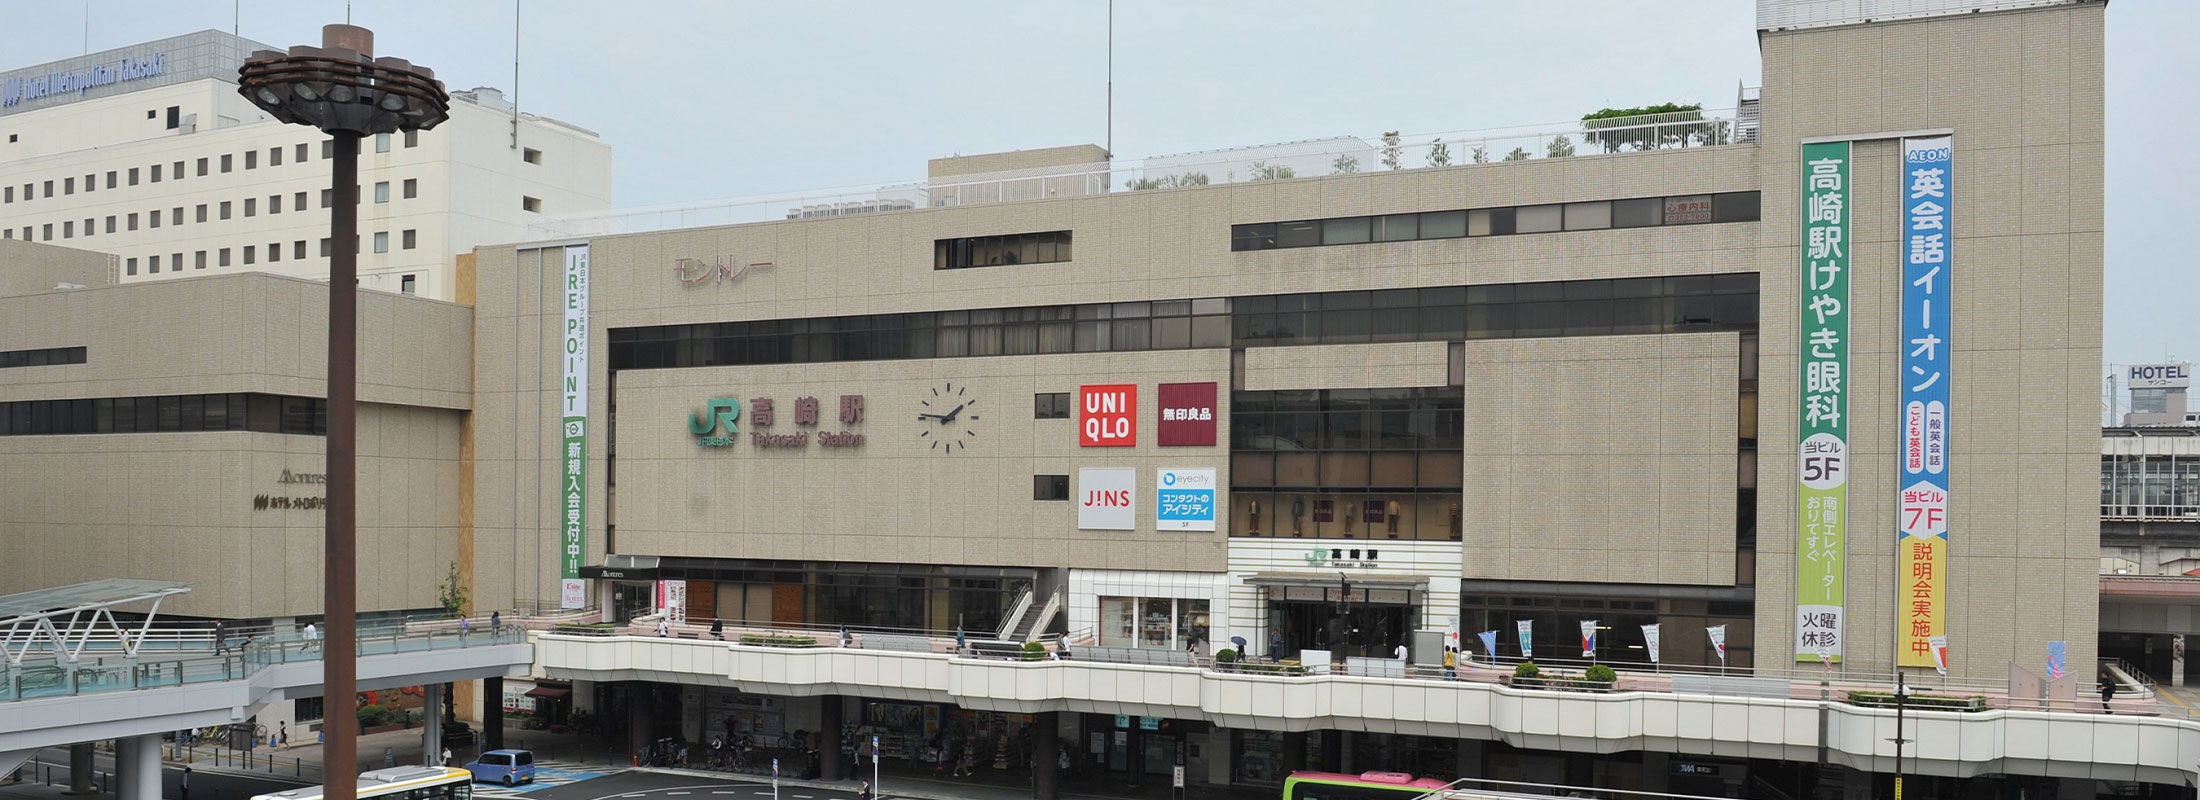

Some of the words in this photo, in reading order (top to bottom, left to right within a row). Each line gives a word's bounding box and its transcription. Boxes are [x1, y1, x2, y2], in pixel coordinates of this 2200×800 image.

[24, 74, 48, 100] Hotel
[52, 64, 116, 96] Metropolitan
[120, 52, 167, 82] Takasaki
[1908, 147, 1949, 163] AEON
[673, 254, 775, 284] モントレー
[1911, 168, 1944, 392] 英会話イーオン
[568, 254, 578, 309] JRE
[1806, 158, 1843, 428] 高崎駅けやき眼科
[566, 319, 578, 412] POINT
[2131, 366, 2188, 379] HOTEL
[750, 395, 865, 426] 高崎駅
[1086, 392, 1126, 414] UNI
[1163, 407, 1212, 421] 無印良品
[689, 397, 740, 434] JR
[750, 431, 808, 447] Takasaki
[817, 431, 865, 447] Station
[1085, 417, 1129, 442] QLO
[1909, 405, 1921, 469] こども英会話
[1929, 412, 1941, 466] 一般英会話
[1804, 441, 1841, 454] 当ビル
[1177, 474, 1209, 484] eyecity
[1803, 457, 1841, 481] 5F
[1162, 504, 1209, 515] アイシティ
[1163, 494, 1209, 503] コンタクトの
[1904, 491, 1944, 504] 当ビル
[1806, 496, 1820, 562] おりてすぐ
[1904, 508, 1943, 530] 7F
[1305, 547, 1328, 562] JR
[1822, 496, 1838, 601] 南側エレベーター
[1911, 543, 1932, 657] 説明会実施中
[1802, 612, 1837, 630] 火曜
[1801, 631, 1836, 648] 休診
